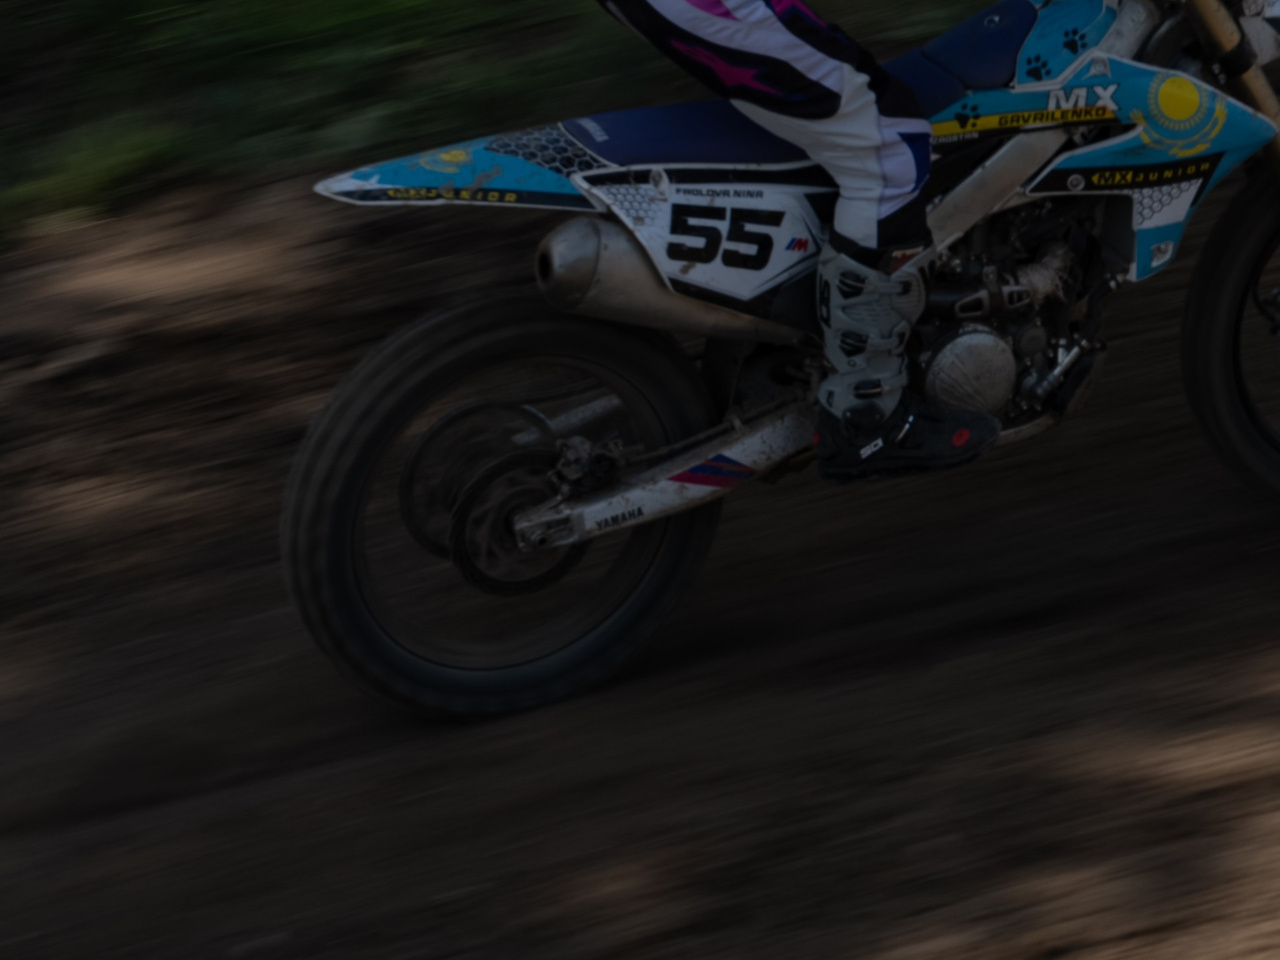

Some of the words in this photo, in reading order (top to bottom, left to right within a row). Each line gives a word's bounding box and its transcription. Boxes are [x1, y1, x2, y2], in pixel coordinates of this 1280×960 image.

[1047, 83, 1121, 111] MX
[998, 105, 1107, 127] GAVRILENKO
[667, 203, 786, 270] 55
[596, 506, 645, 529] YAMAHA
